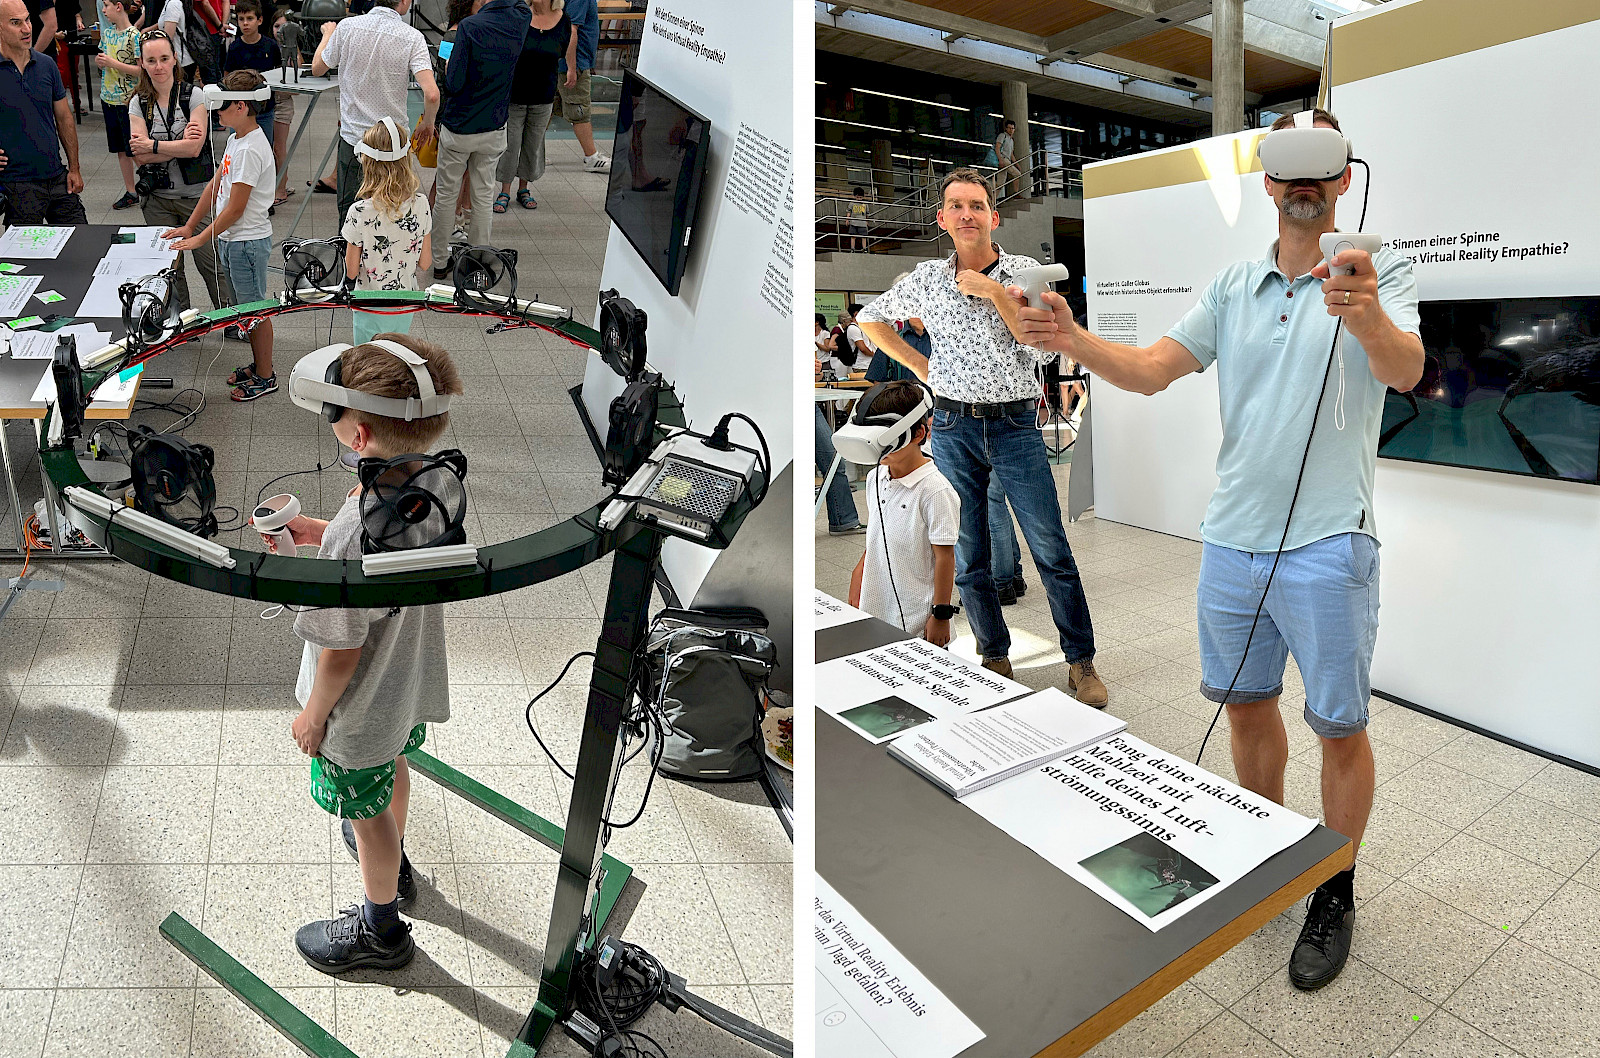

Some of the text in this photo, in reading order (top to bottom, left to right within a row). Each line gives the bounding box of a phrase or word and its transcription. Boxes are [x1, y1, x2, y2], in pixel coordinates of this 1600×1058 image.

[1392, 238, 1427, 250] Sinnen
[1429, 235, 1457, 247] einer
[1460, 231, 1500, 247] Spinne
[1419, 251, 1456, 264] Virtual
[1458, 247, 1499, 263] Reality
[1501, 241, 1569, 261] Empathie?
[1147, 287, 1163, 296] Objekt
[1163, 286, 1193, 294] erforschbar?
[845, 656, 903, 688] austauschst
[885, 646, 971, 691] indem du mit ihr
[903, 640, 1007, 695] Finde eine Partnerin,
[926, 682, 970, 707] Signale
[1062, 754, 1215, 838] Hilfe deines Luft-
[1085, 745, 1195, 804] Mahlzeit mit
[1105, 736, 1271, 820] Fang deine nächste
[1039, 764, 1177, 843] strömungssinns
[818, 909, 835, 924] das
[831, 920, 865, 952] Virtual
[856, 947, 890, 980] Reality
[884, 976, 926, 1018] Erlebnis
[827, 946, 856, 968] Jagd
[843, 967, 893, 1007] gefallen?
